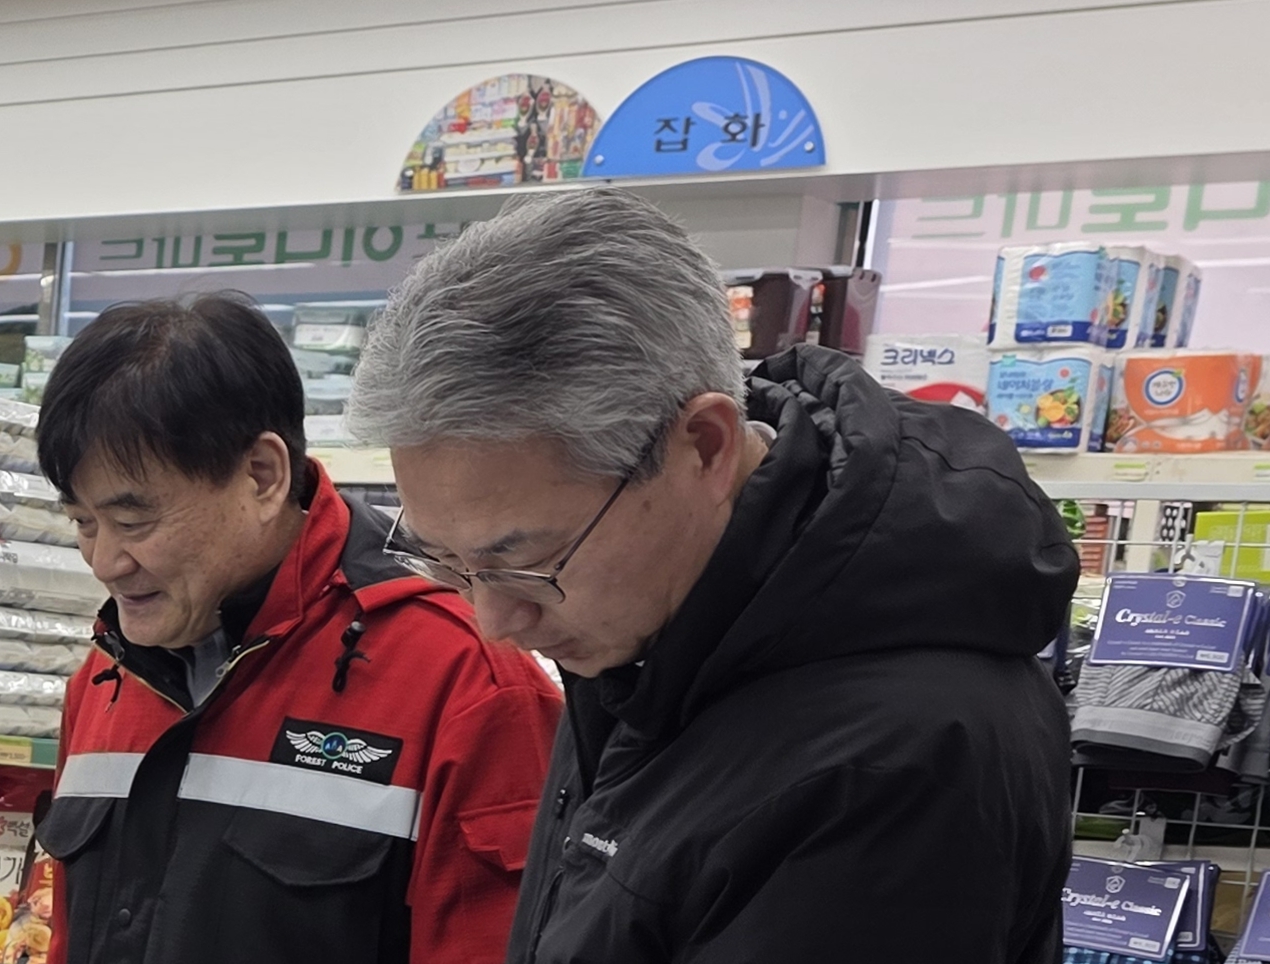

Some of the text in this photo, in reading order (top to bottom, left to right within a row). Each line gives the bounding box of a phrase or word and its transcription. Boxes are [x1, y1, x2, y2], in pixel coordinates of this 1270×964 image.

[652, 112, 766, 154] 잡화
[880, 348, 955, 366] 크리넥스
[1115, 608, 1182, 626] Crystal-e
[295, 754, 364, 774] FOREST POLICE
[6, 820, 30, 838] 백설
